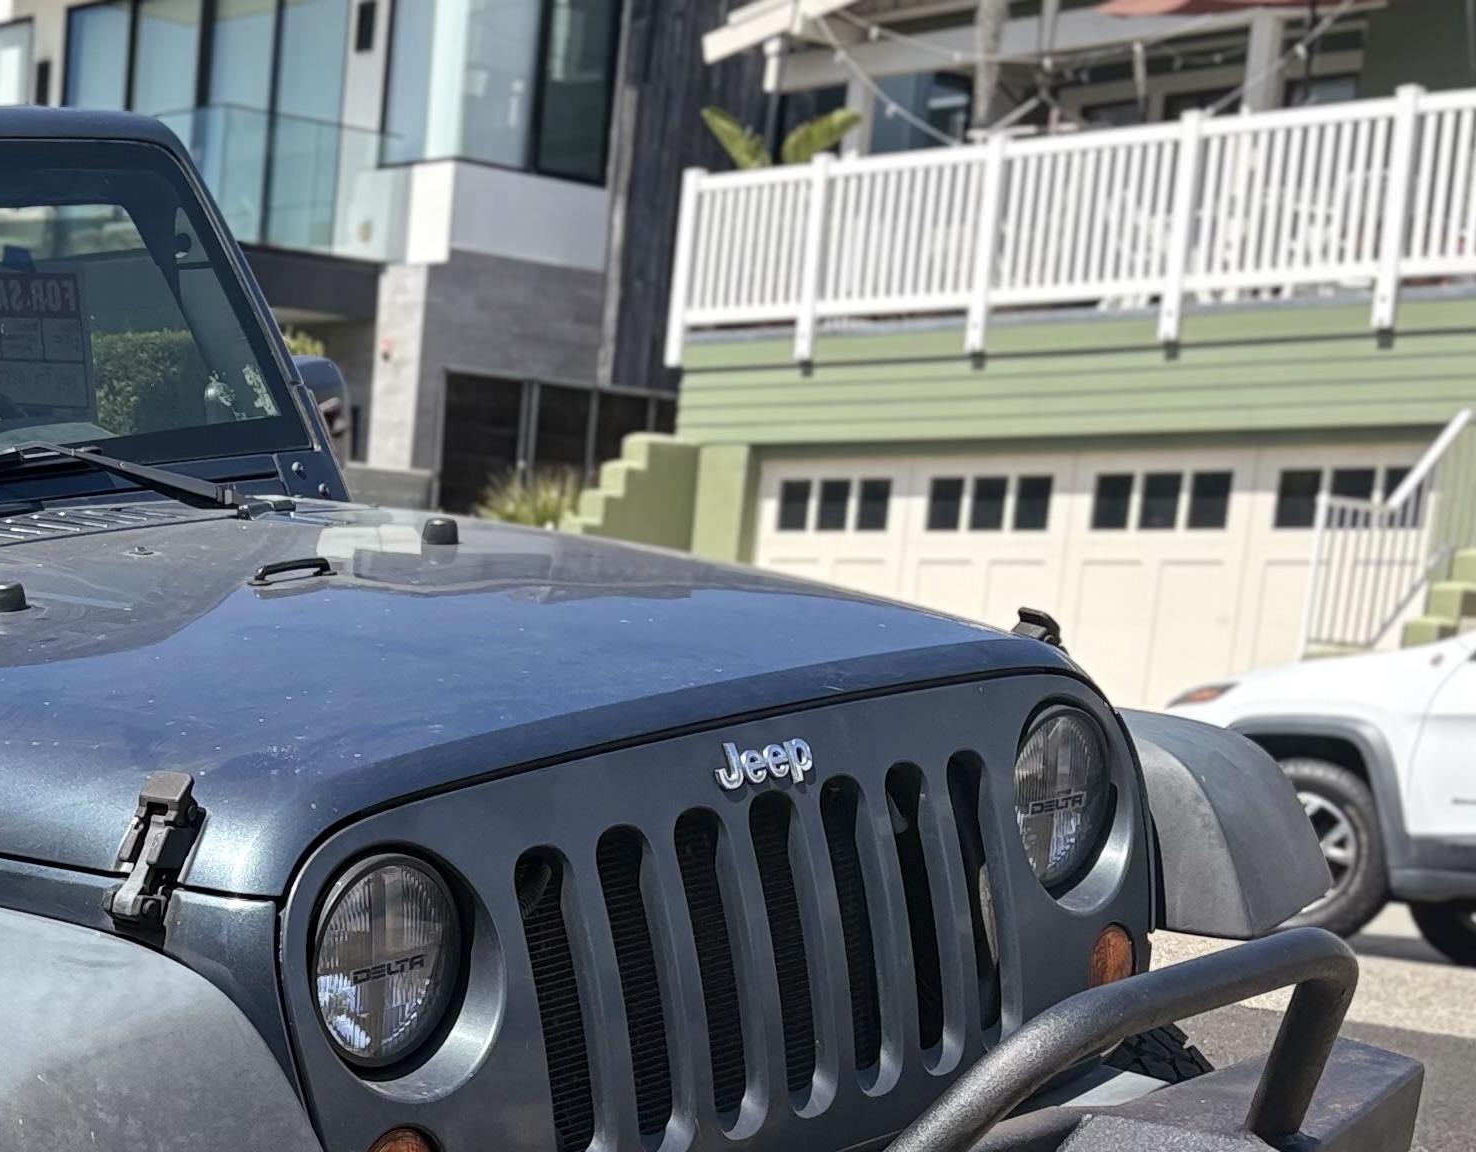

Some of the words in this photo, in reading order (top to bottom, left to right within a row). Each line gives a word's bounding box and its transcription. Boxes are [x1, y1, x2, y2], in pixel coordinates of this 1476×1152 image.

[715, 738, 813, 790] Jeep
[1030, 794, 1084, 816] DELTA
[352, 953, 425, 984] DELTA
